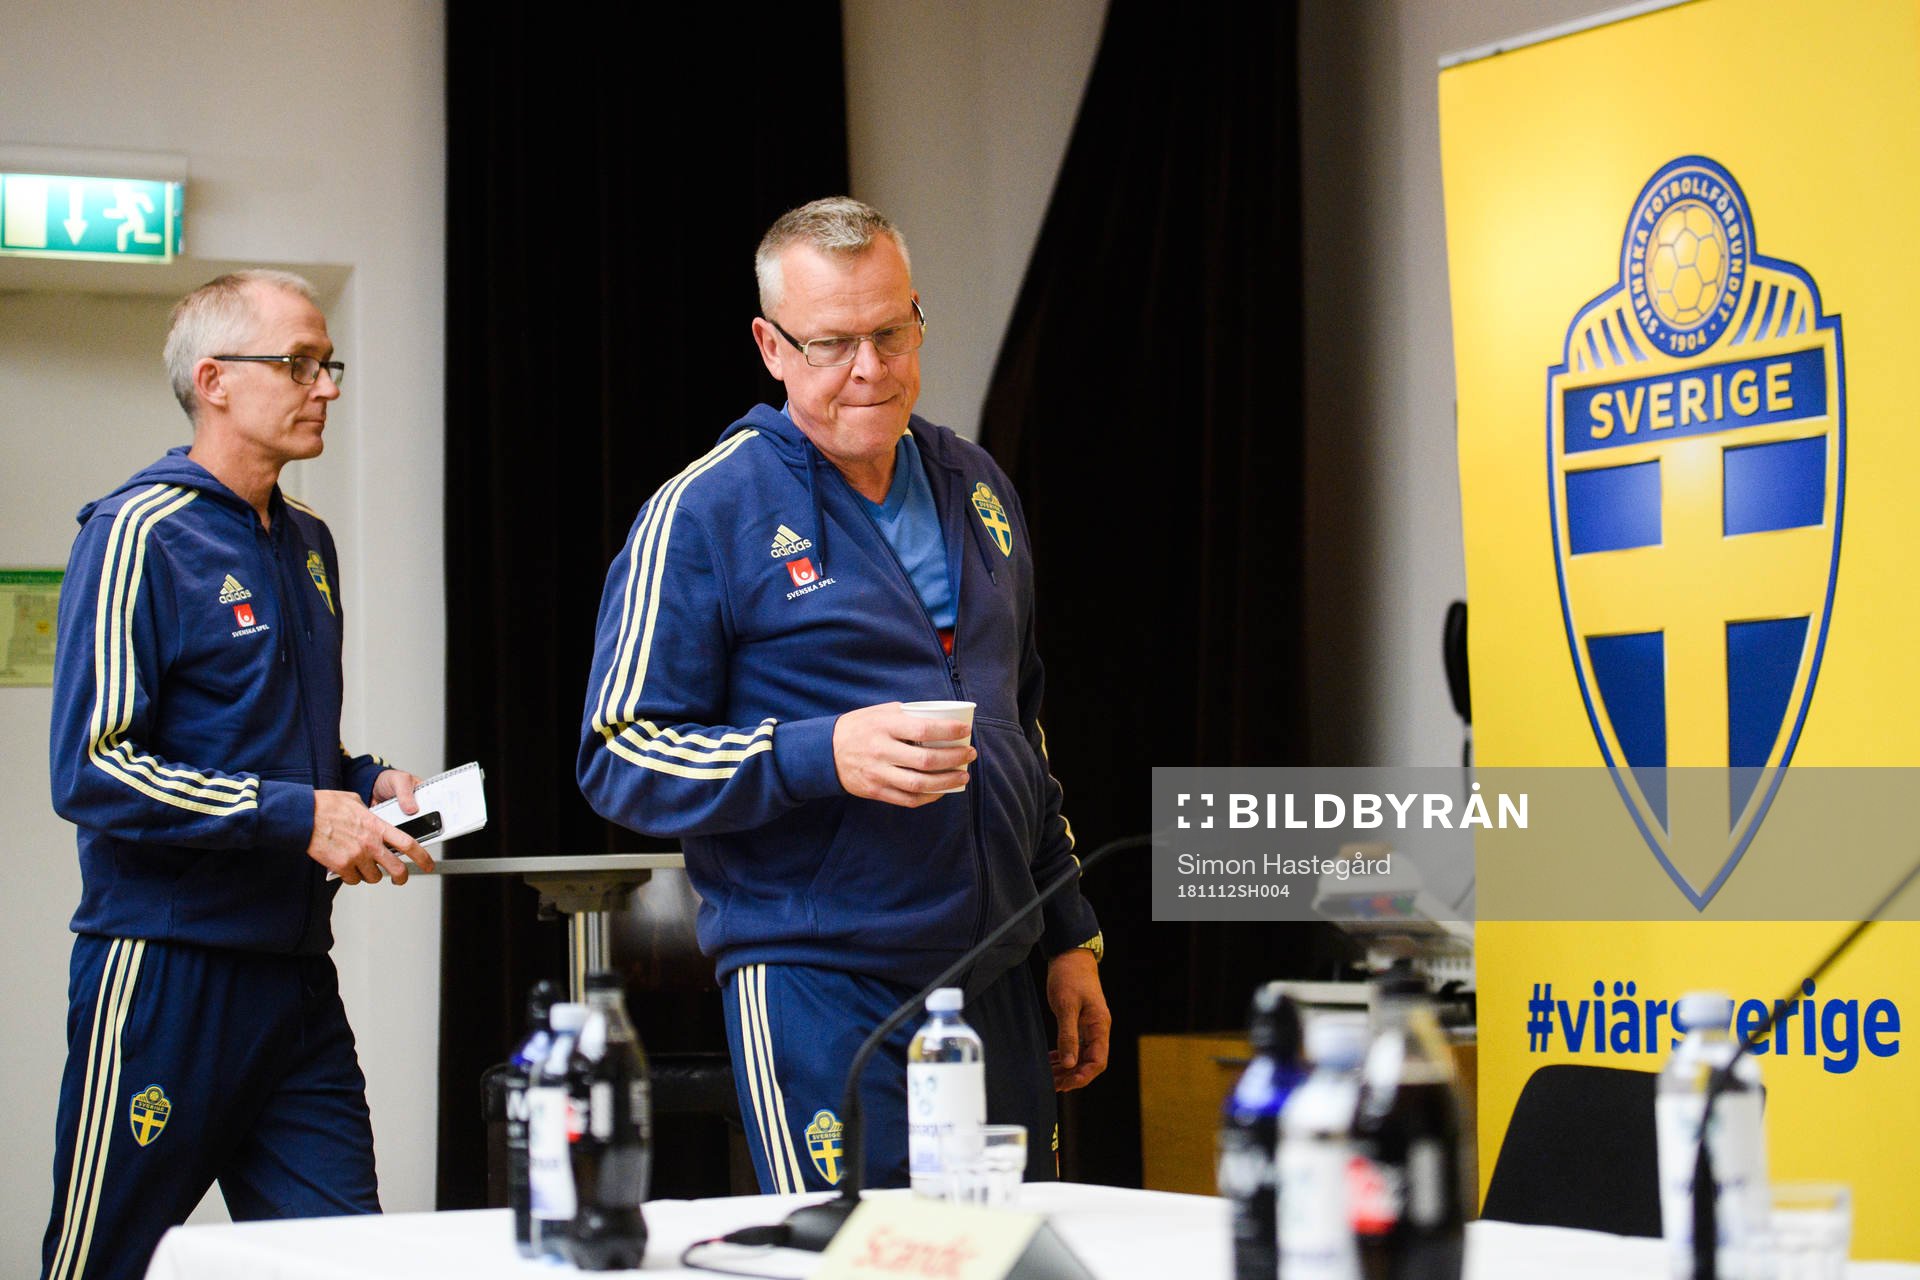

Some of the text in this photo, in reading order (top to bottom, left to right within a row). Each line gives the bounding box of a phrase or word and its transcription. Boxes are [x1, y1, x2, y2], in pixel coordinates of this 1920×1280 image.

[1631, 176, 1744, 335] SVENSKA FOTBOLLFÖRBUNDET
[1669, 329, 1707, 352] 1904
[1588, 361, 1794, 440] SVERIGE
[770, 538, 813, 558] adidas
[218, 589, 252, 604] adidas
[786, 577, 837, 600] SVENSKA SPEL
[1527, 977, 1901, 1075] #viärerige
